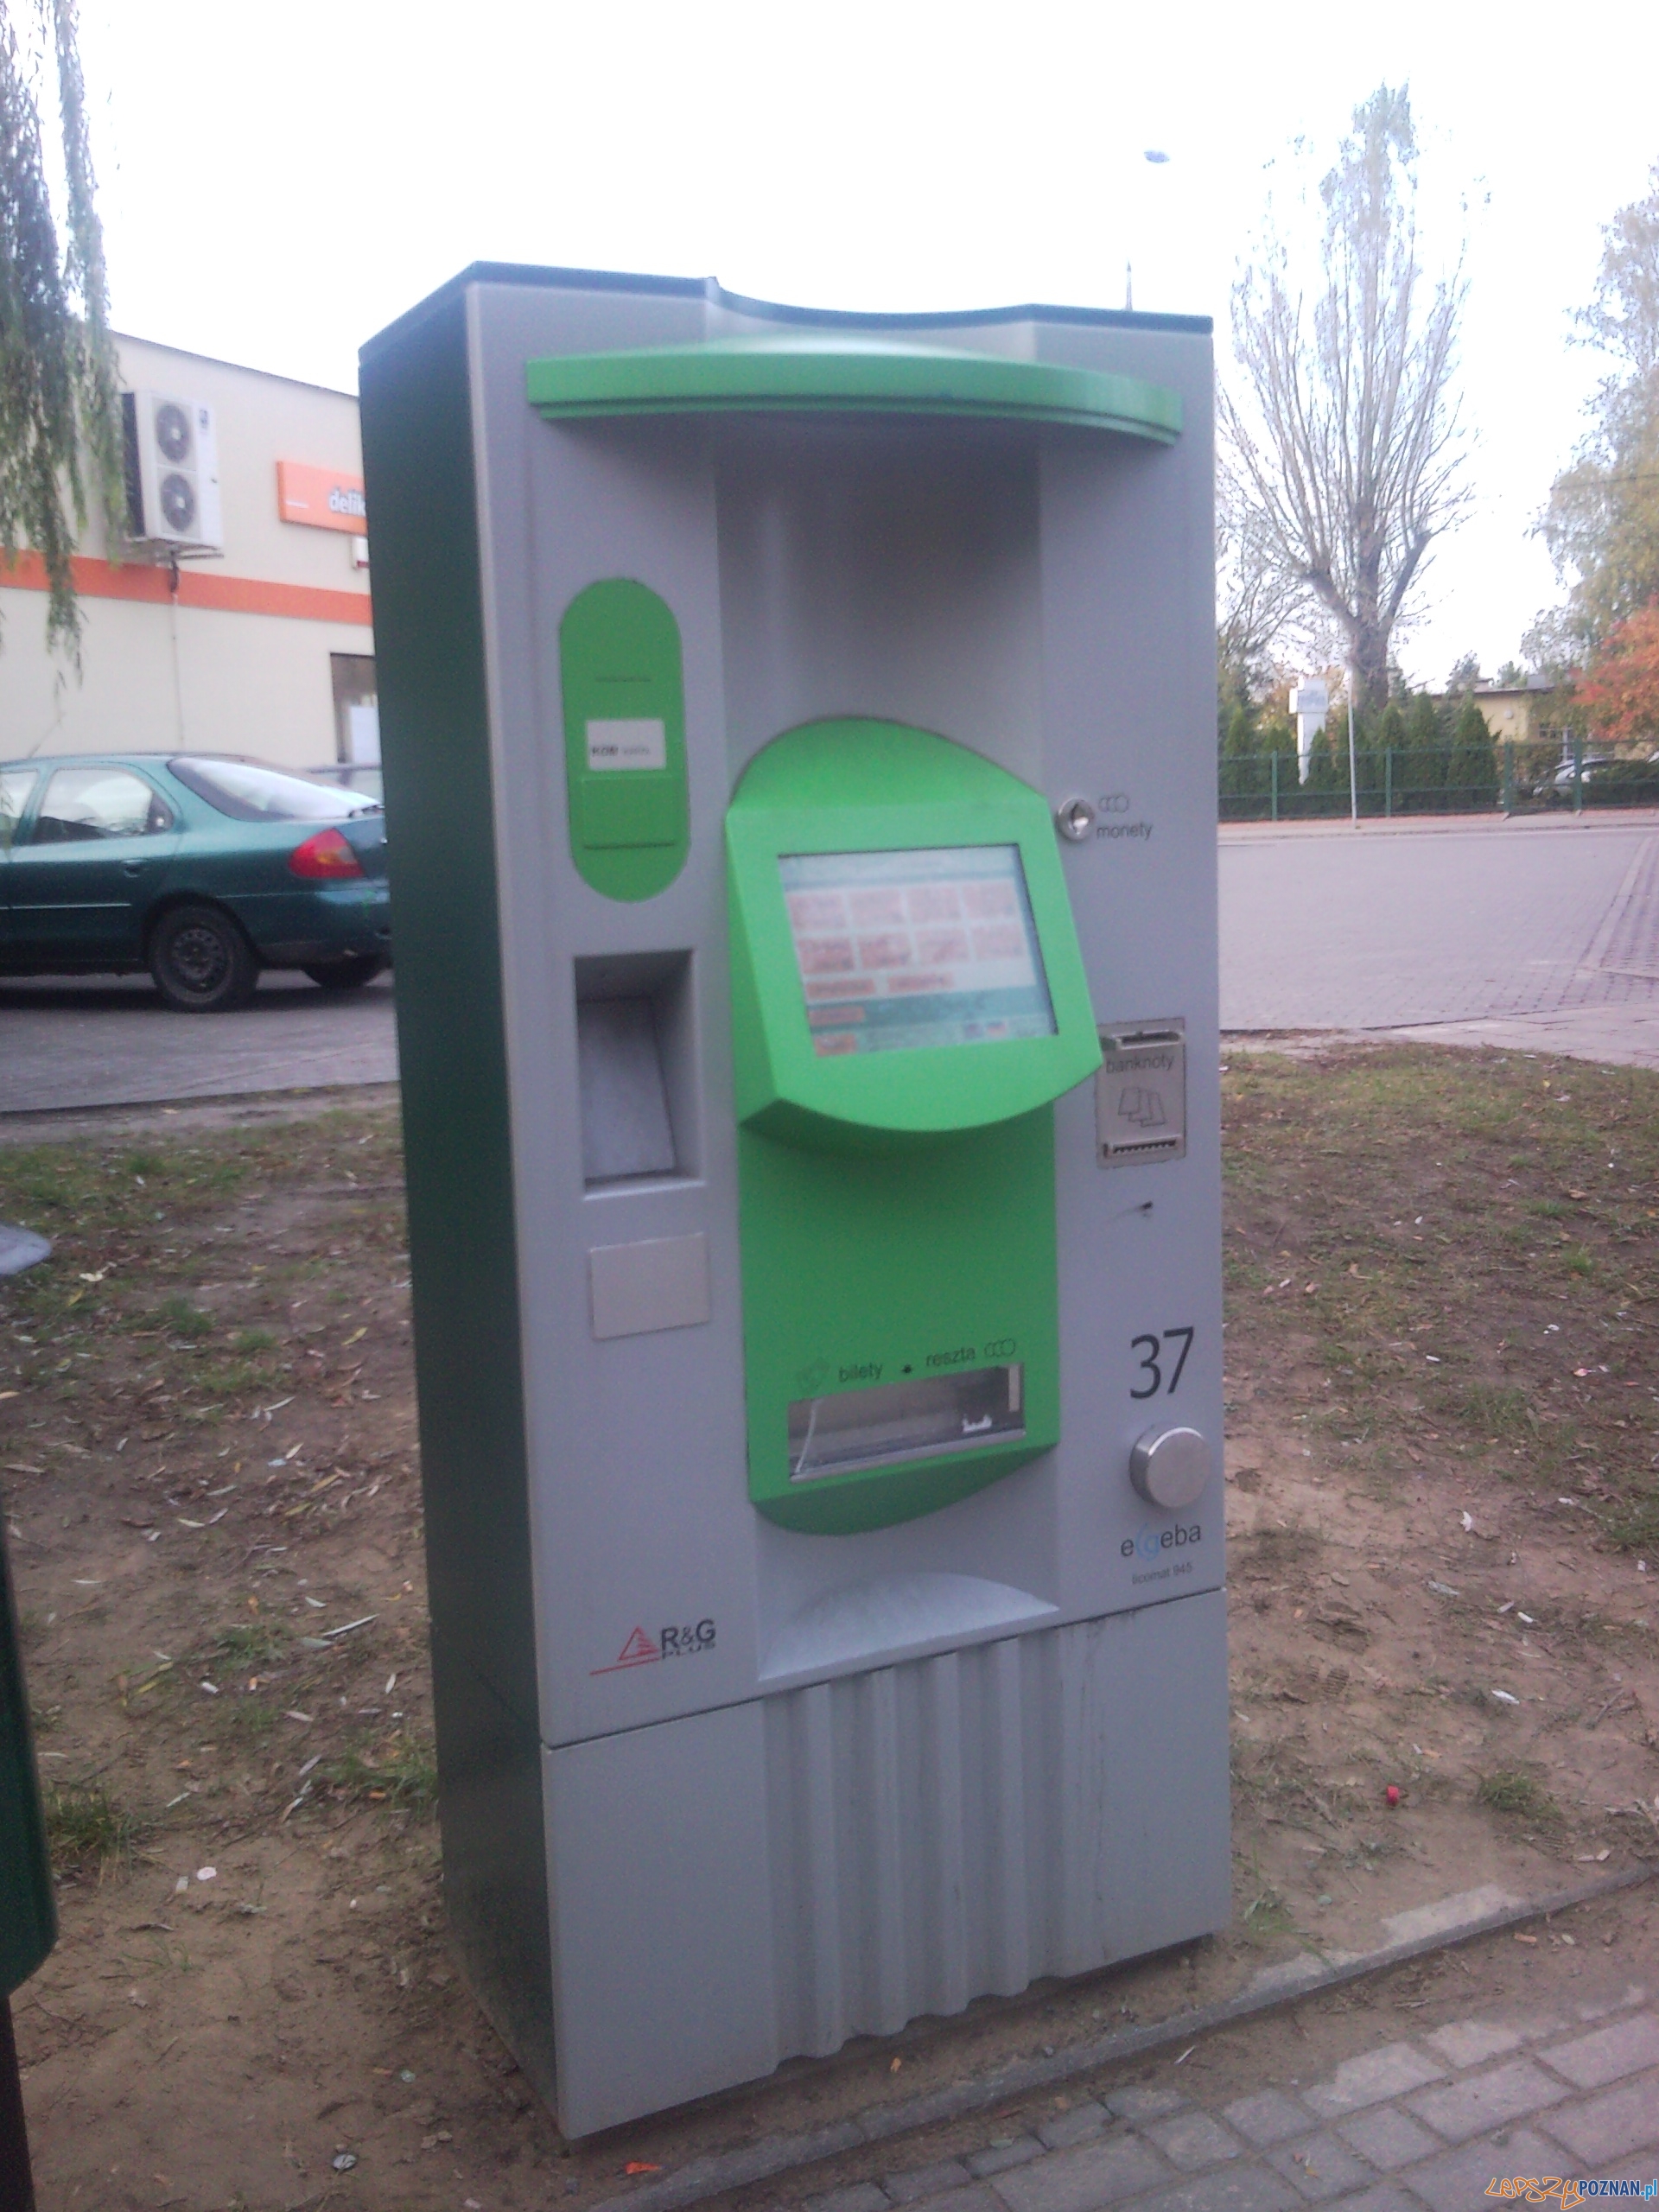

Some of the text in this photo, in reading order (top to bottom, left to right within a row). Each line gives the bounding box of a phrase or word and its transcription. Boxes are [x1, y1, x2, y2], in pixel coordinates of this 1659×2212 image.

[1096, 823, 1153, 841] monety
[1106, 1054, 1174, 1074] banknoty
[838, 1345, 976, 1382] bilety reszta
[1130, 1325, 1194, 1399] 37
[661, 1618, 716, 1651] R&G
